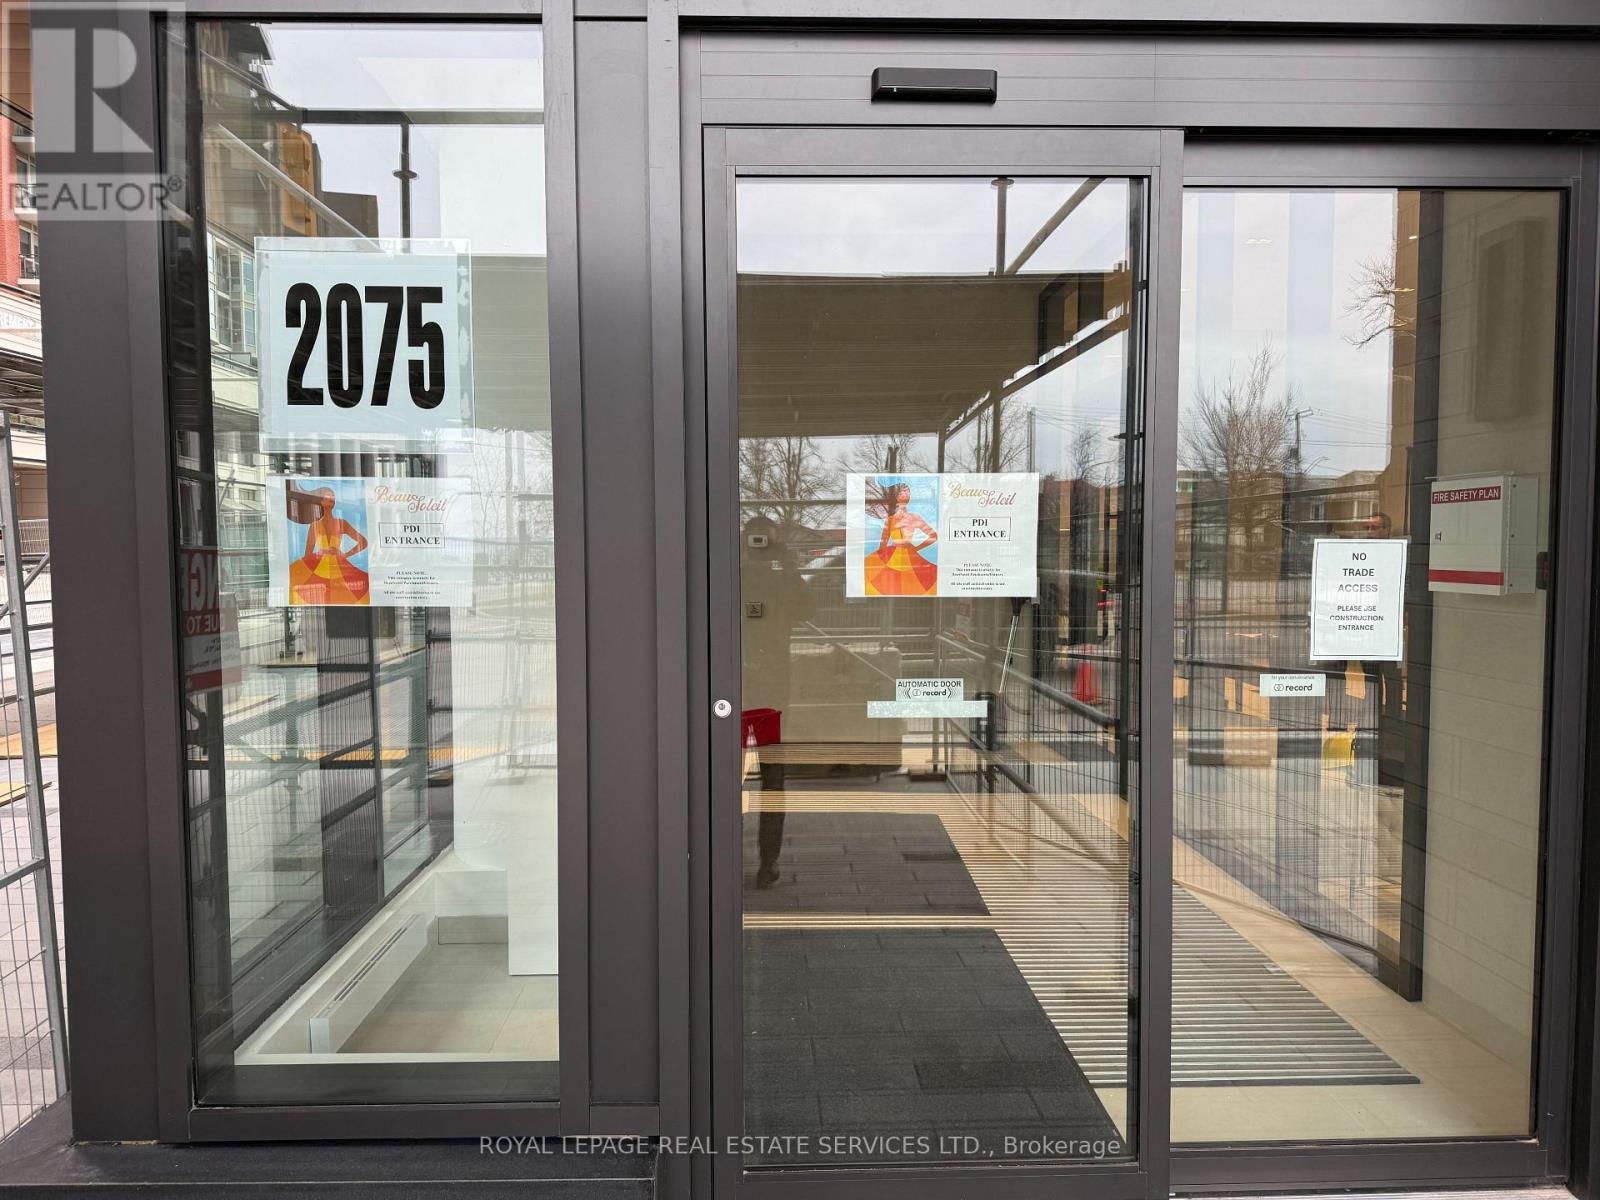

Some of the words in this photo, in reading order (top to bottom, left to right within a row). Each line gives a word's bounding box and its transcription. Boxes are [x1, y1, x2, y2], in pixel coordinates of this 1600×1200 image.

[285, 282, 445, 410] 2075
[948, 481, 988, 499] Beau
[978, 490, 1017, 508] Soleil
[1433, 492, 1449, 503] FIRE
[1450, 489, 1477, 502] SAFETY
[1478, 488, 1499, 500] PLAN
[408, 496, 448, 513] Soleil
[972, 518, 988, 527] PDI
[403, 525, 420, 533] PDI
[953, 530, 1007, 538] ENTRANCE
[384, 536, 442, 545] ENTRANCE
[1352, 552, 1367, 561] NO
[1342, 568, 1375, 577] TRADE
[1337, 584, 1378, 593] ACCESS
[1285, 684, 1313, 692] record
